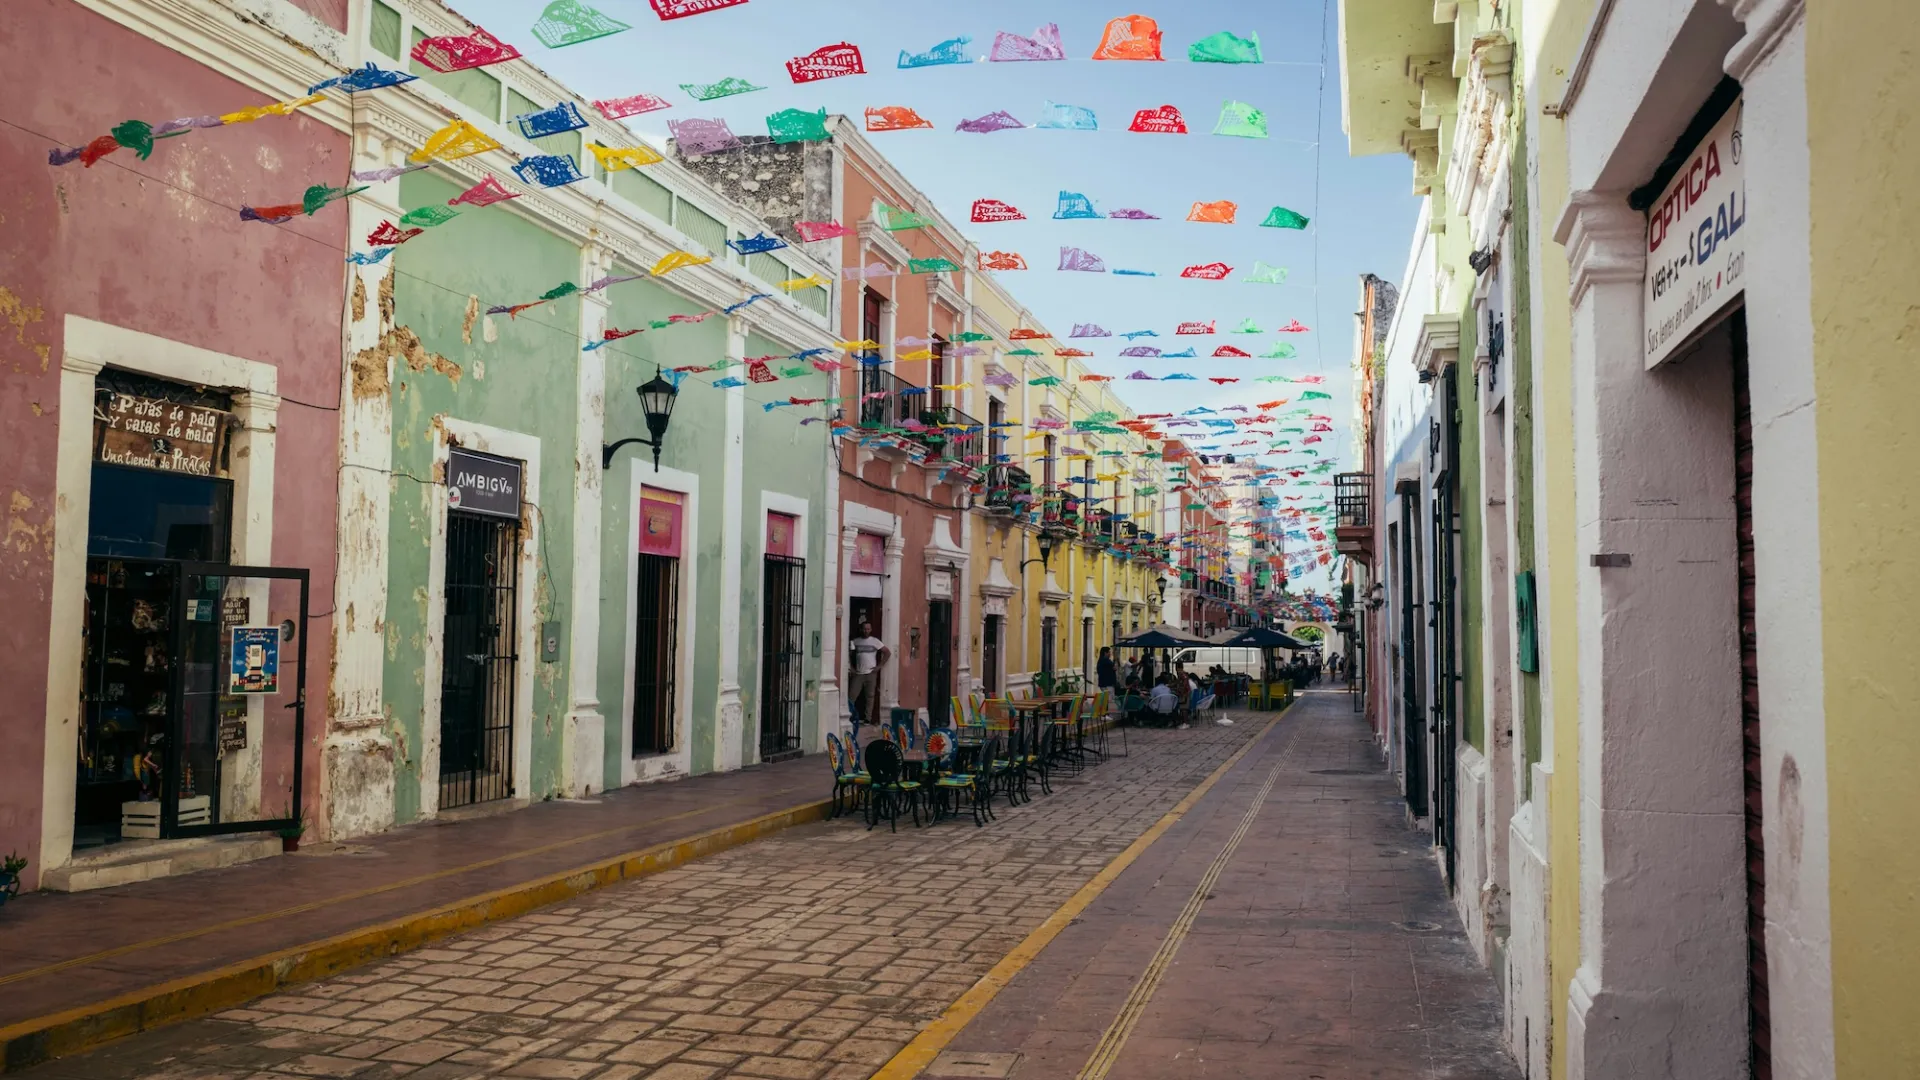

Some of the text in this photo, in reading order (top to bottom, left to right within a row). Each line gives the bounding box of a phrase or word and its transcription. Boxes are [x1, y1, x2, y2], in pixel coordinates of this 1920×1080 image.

[1650, 140, 1721, 252] OPTICA
[1698, 188, 1745, 265] GAL
[1647, 328, 1659, 355] Sus
[117, 398, 216, 428] Patas de palo
[125, 418, 161, 435] caras
[166, 422, 181, 438] de
[101, 443, 123, 464] Una
[125, 450, 156, 468] tienda
[159, 457, 170, 470] de
